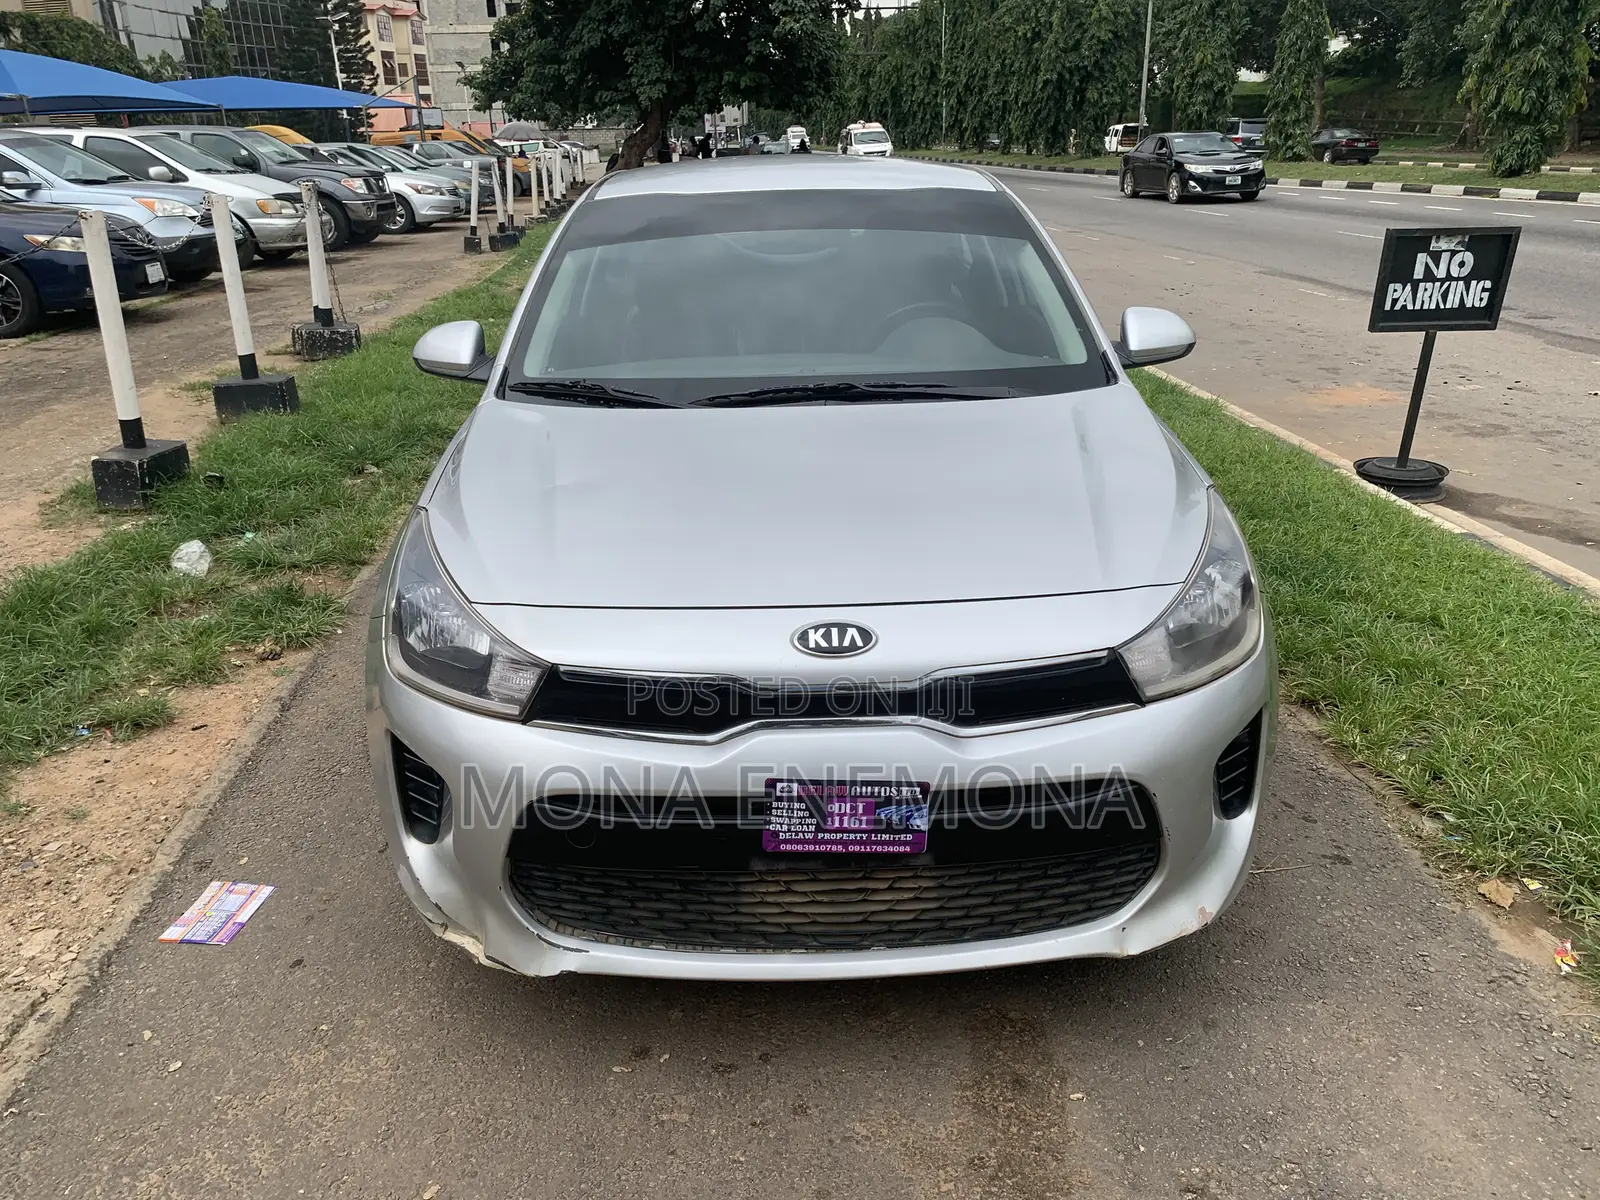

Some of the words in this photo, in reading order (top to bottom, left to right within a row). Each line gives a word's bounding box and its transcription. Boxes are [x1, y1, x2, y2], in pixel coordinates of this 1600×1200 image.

[1413, 251, 1474, 279] NO
[1384, 279, 1492, 311] PARKING
[807, 627, 864, 648] KIA
[850, 785, 899, 797] AUTOS
[772, 801, 806, 810] BUYING
[771, 809, 810, 817] SELLING
[770, 816, 817, 825] SWAPPING
[769, 824, 788, 832] CAR
[779, 832, 814, 840] DELAW
[871, 833, 913, 841] LIMITED
